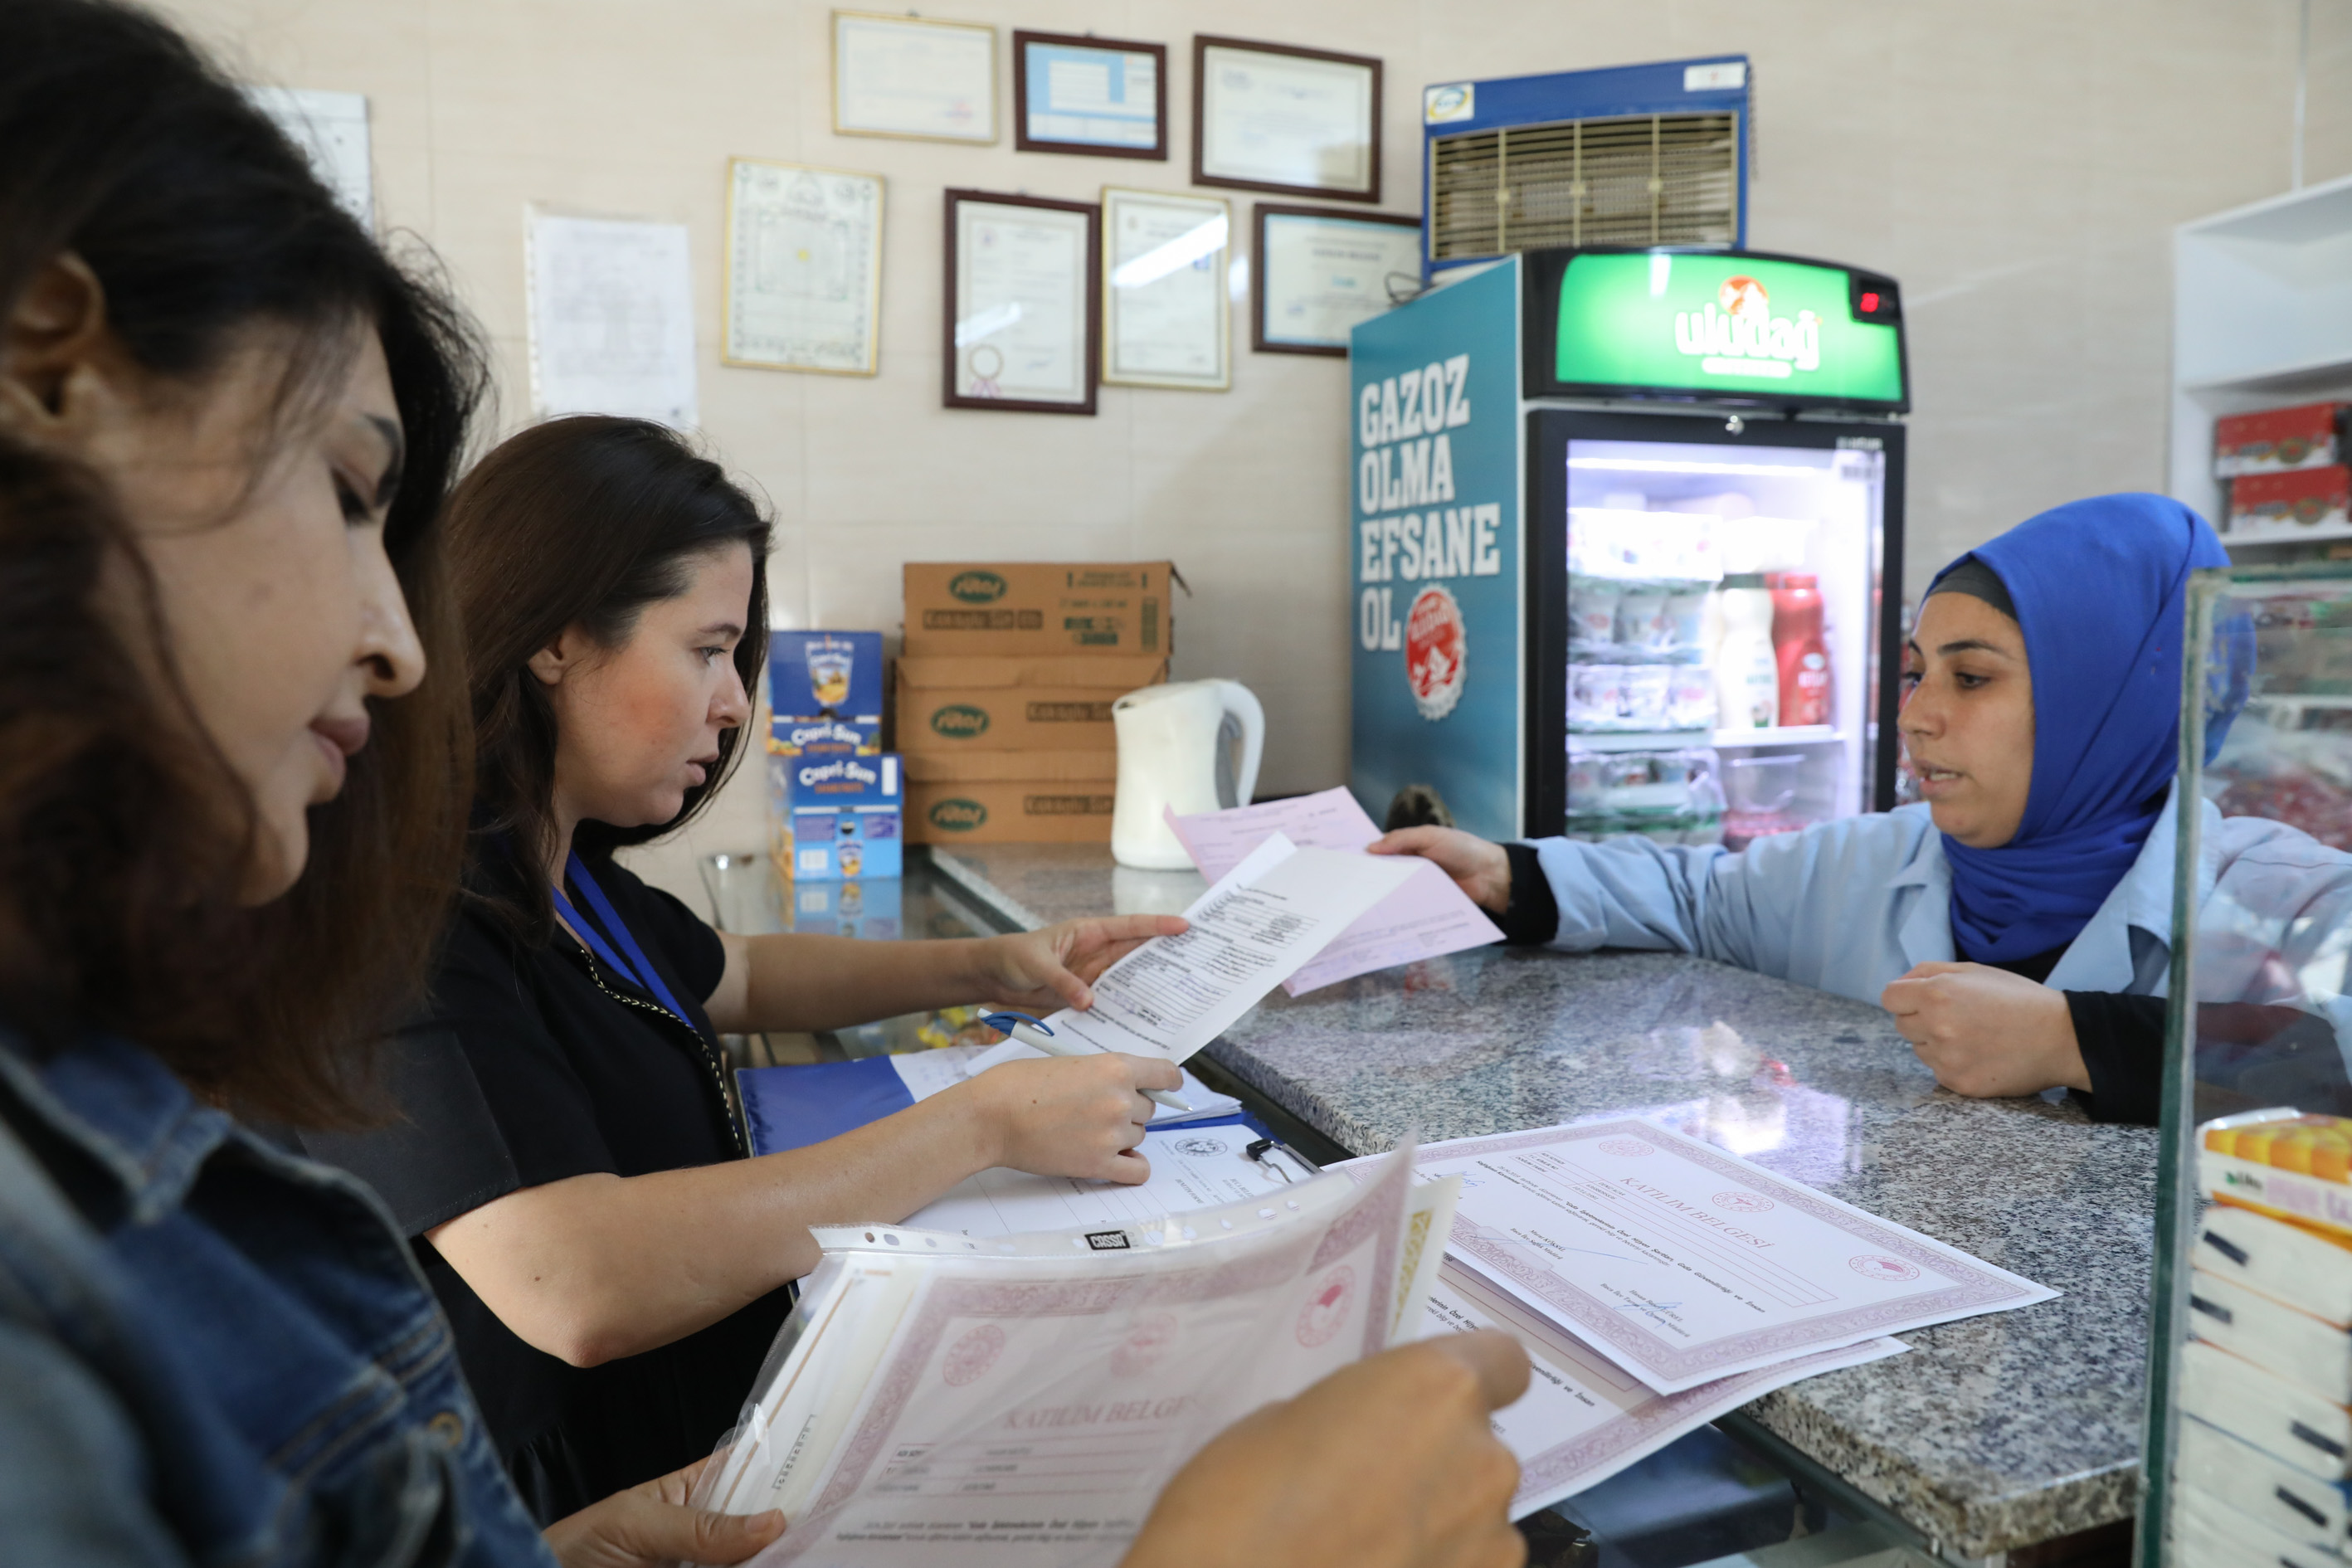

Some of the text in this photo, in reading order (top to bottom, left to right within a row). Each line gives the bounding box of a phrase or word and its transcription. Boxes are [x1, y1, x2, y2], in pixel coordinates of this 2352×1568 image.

[1360, 354, 1470, 448] GAZOZ
[1360, 434, 1455, 514] OLMA
[1361, 502, 1500, 582] EFSANE
[1361, 587, 1401, 651] OL
[1089, 1233, 1127, 1249] CASSA
[1619, 1177, 1695, 1211] KATILIM
[1689, 1211, 1775, 1249] BELGESİ
[1449, 1309, 1464, 1320] Özel
[1745, 1301, 1765, 1312] İnsan
[1563, 1385, 1574, 1393] ve
[1574, 1391, 1595, 1407] İnsan
